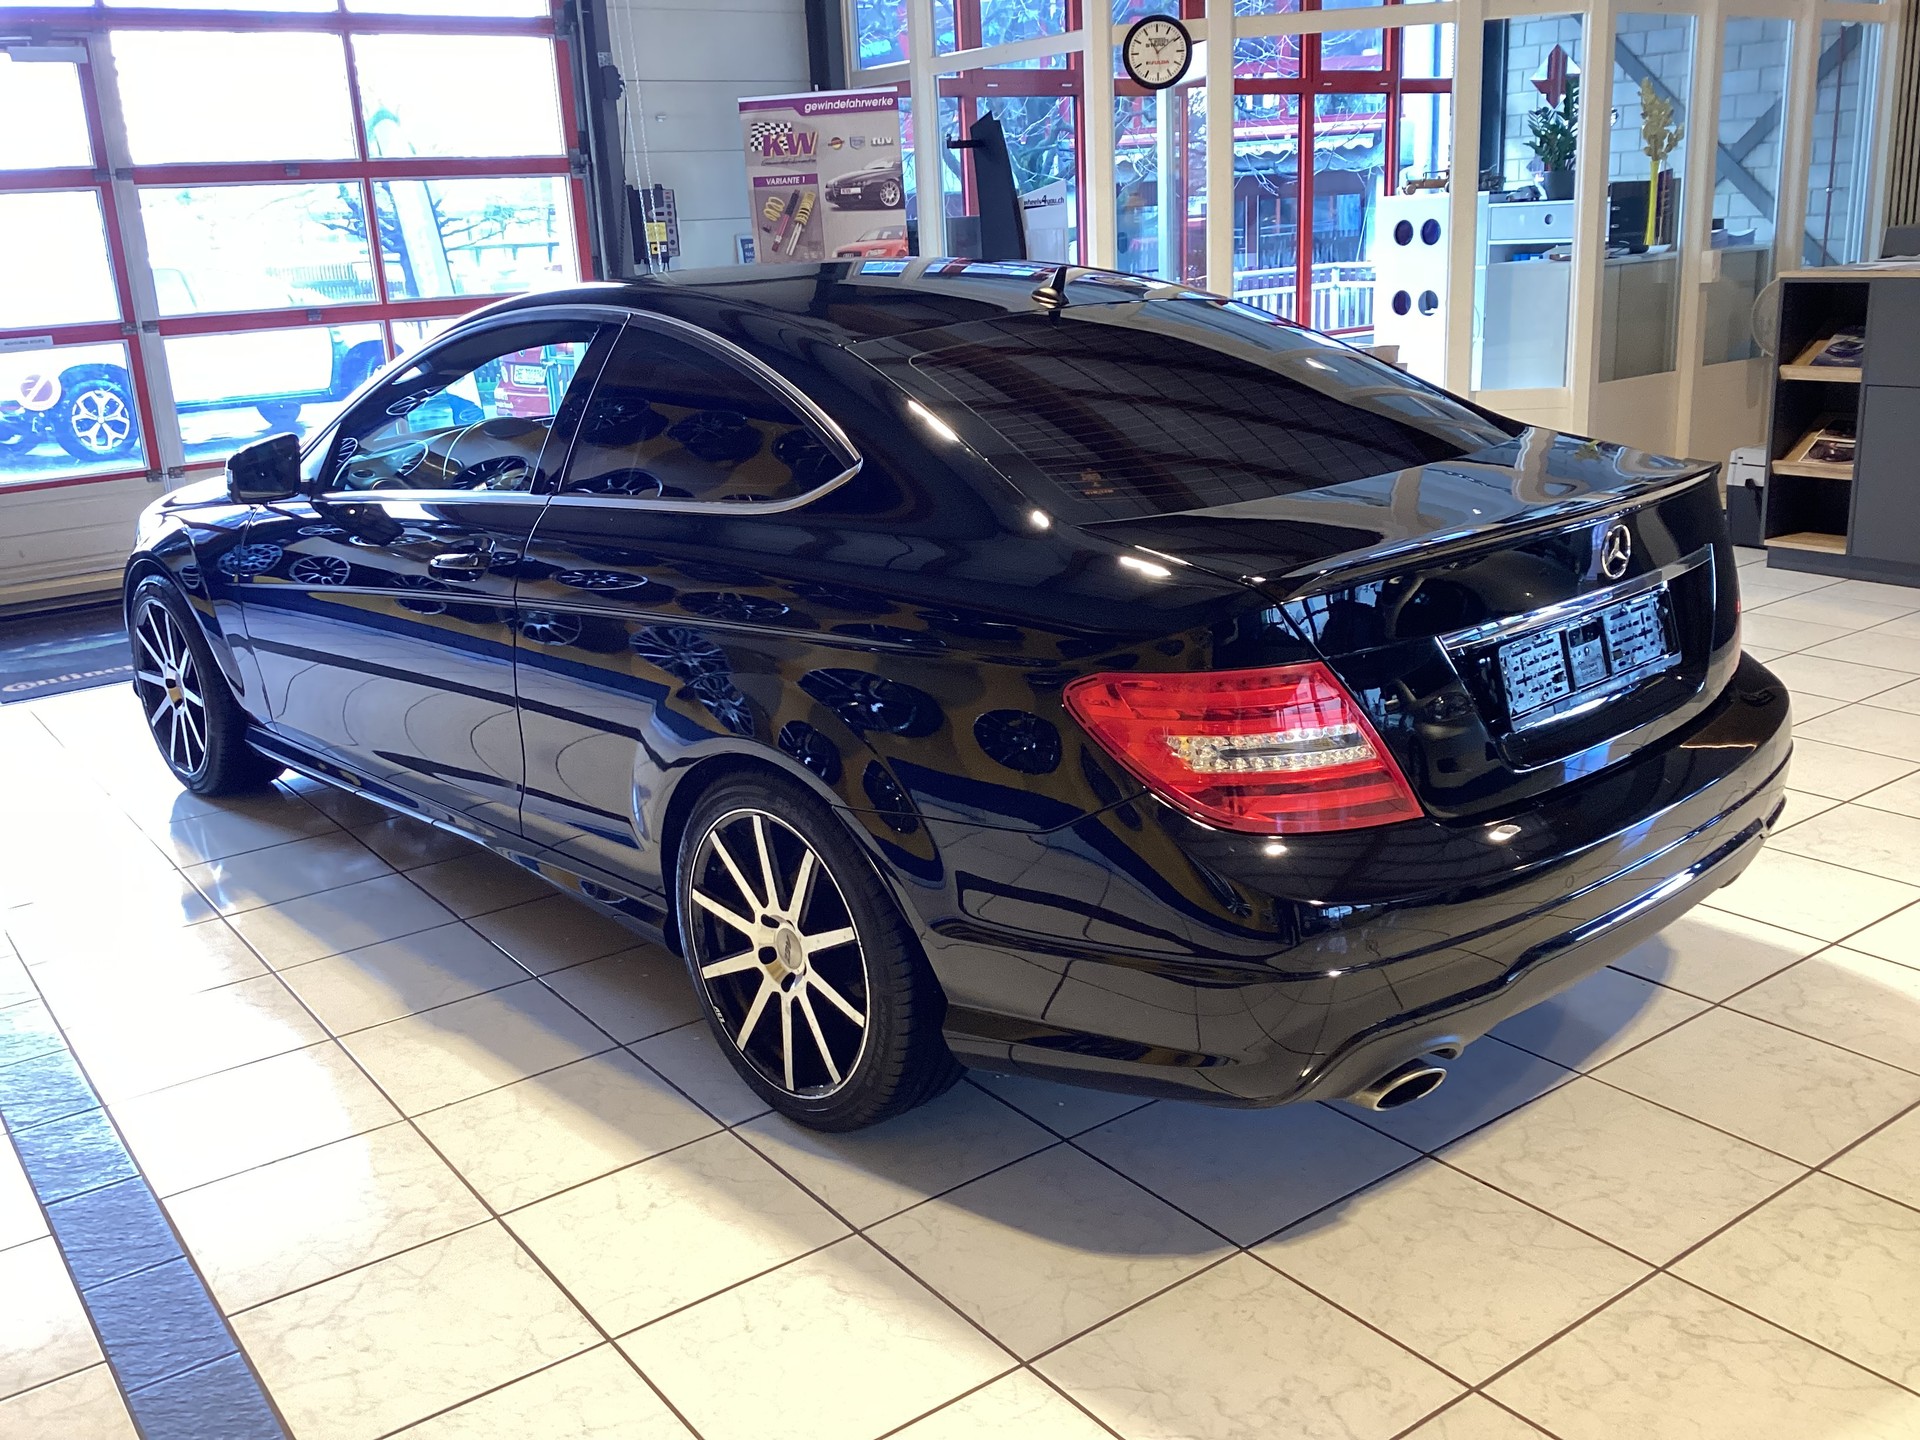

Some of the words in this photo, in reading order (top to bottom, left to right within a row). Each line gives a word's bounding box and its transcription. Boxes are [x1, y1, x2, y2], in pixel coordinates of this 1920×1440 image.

[804, 96, 894, 114] gewindefahrwerke
[763, 131, 819, 158] KW
[765, 177, 801, 186] VARIANTE
[802, 176, 806, 184] 1
